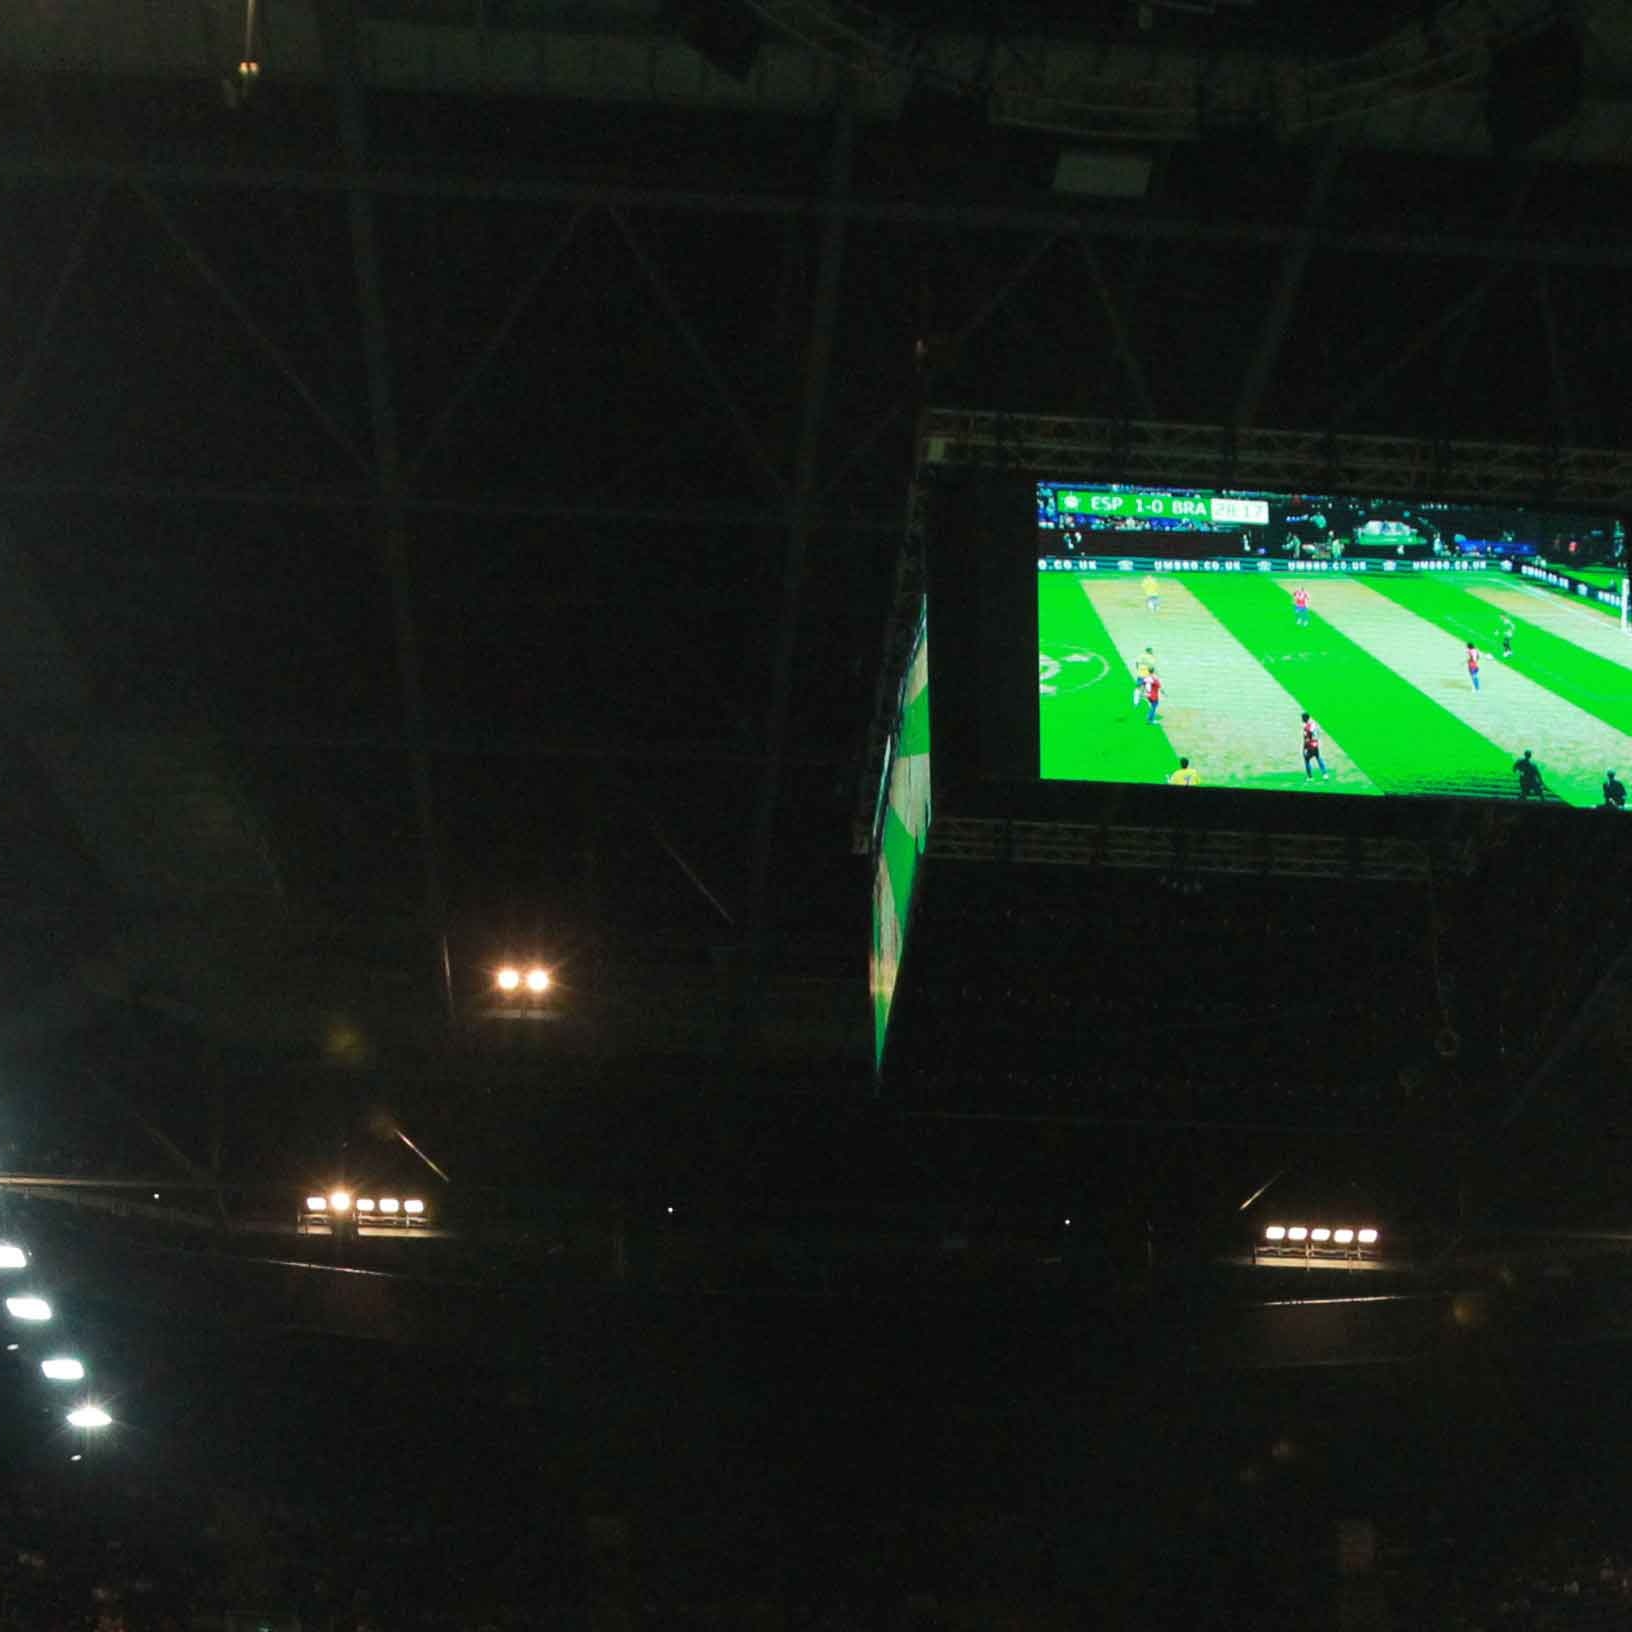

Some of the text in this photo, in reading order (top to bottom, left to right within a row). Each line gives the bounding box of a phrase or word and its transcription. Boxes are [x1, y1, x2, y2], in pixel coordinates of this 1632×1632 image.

[1090, 495, 1123, 511] ESP
[1135, 498, 1164, 514] 1-0
[1171, 500, 1207, 516] BRA
